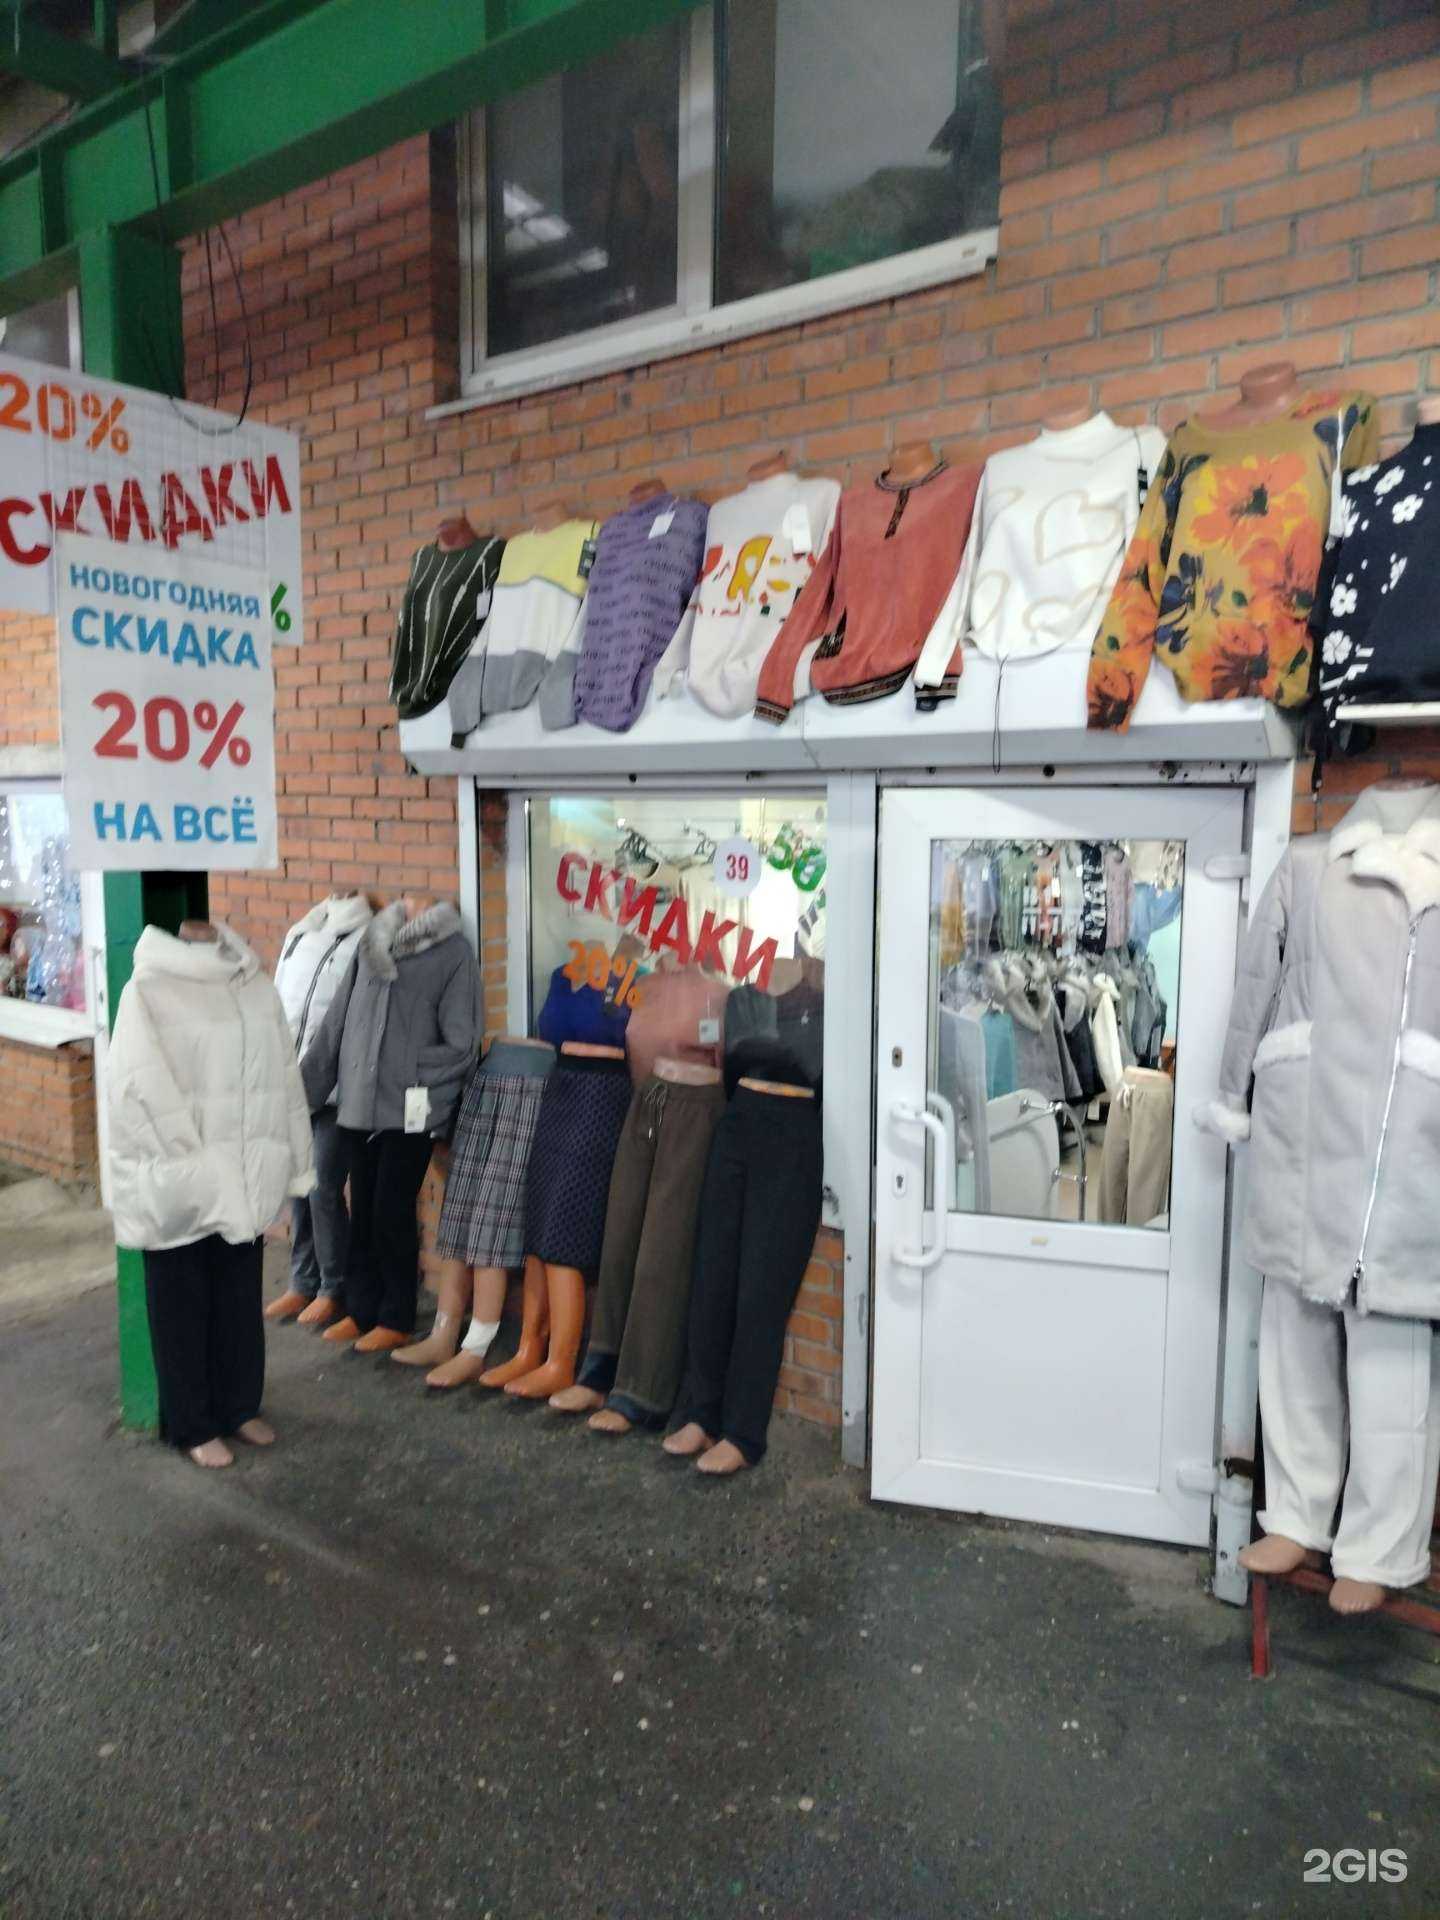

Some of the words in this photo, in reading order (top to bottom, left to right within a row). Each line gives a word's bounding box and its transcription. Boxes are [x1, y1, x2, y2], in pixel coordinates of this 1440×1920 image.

[0, 373, 130, 455] 20%
[0, 454, 292, 566] СКИДКИ
[69, 564, 261, 618] НОВОГОДНЯЯ
[72, 606, 260, 669] СКИДКА
[92, 690, 252, 769] 20%
[93, 802, 162, 842] НА
[172, 797, 258, 843] ВСЁ
[726, 853, 749, 882] 39
[556, 851, 779, 993] СКИДКИ
